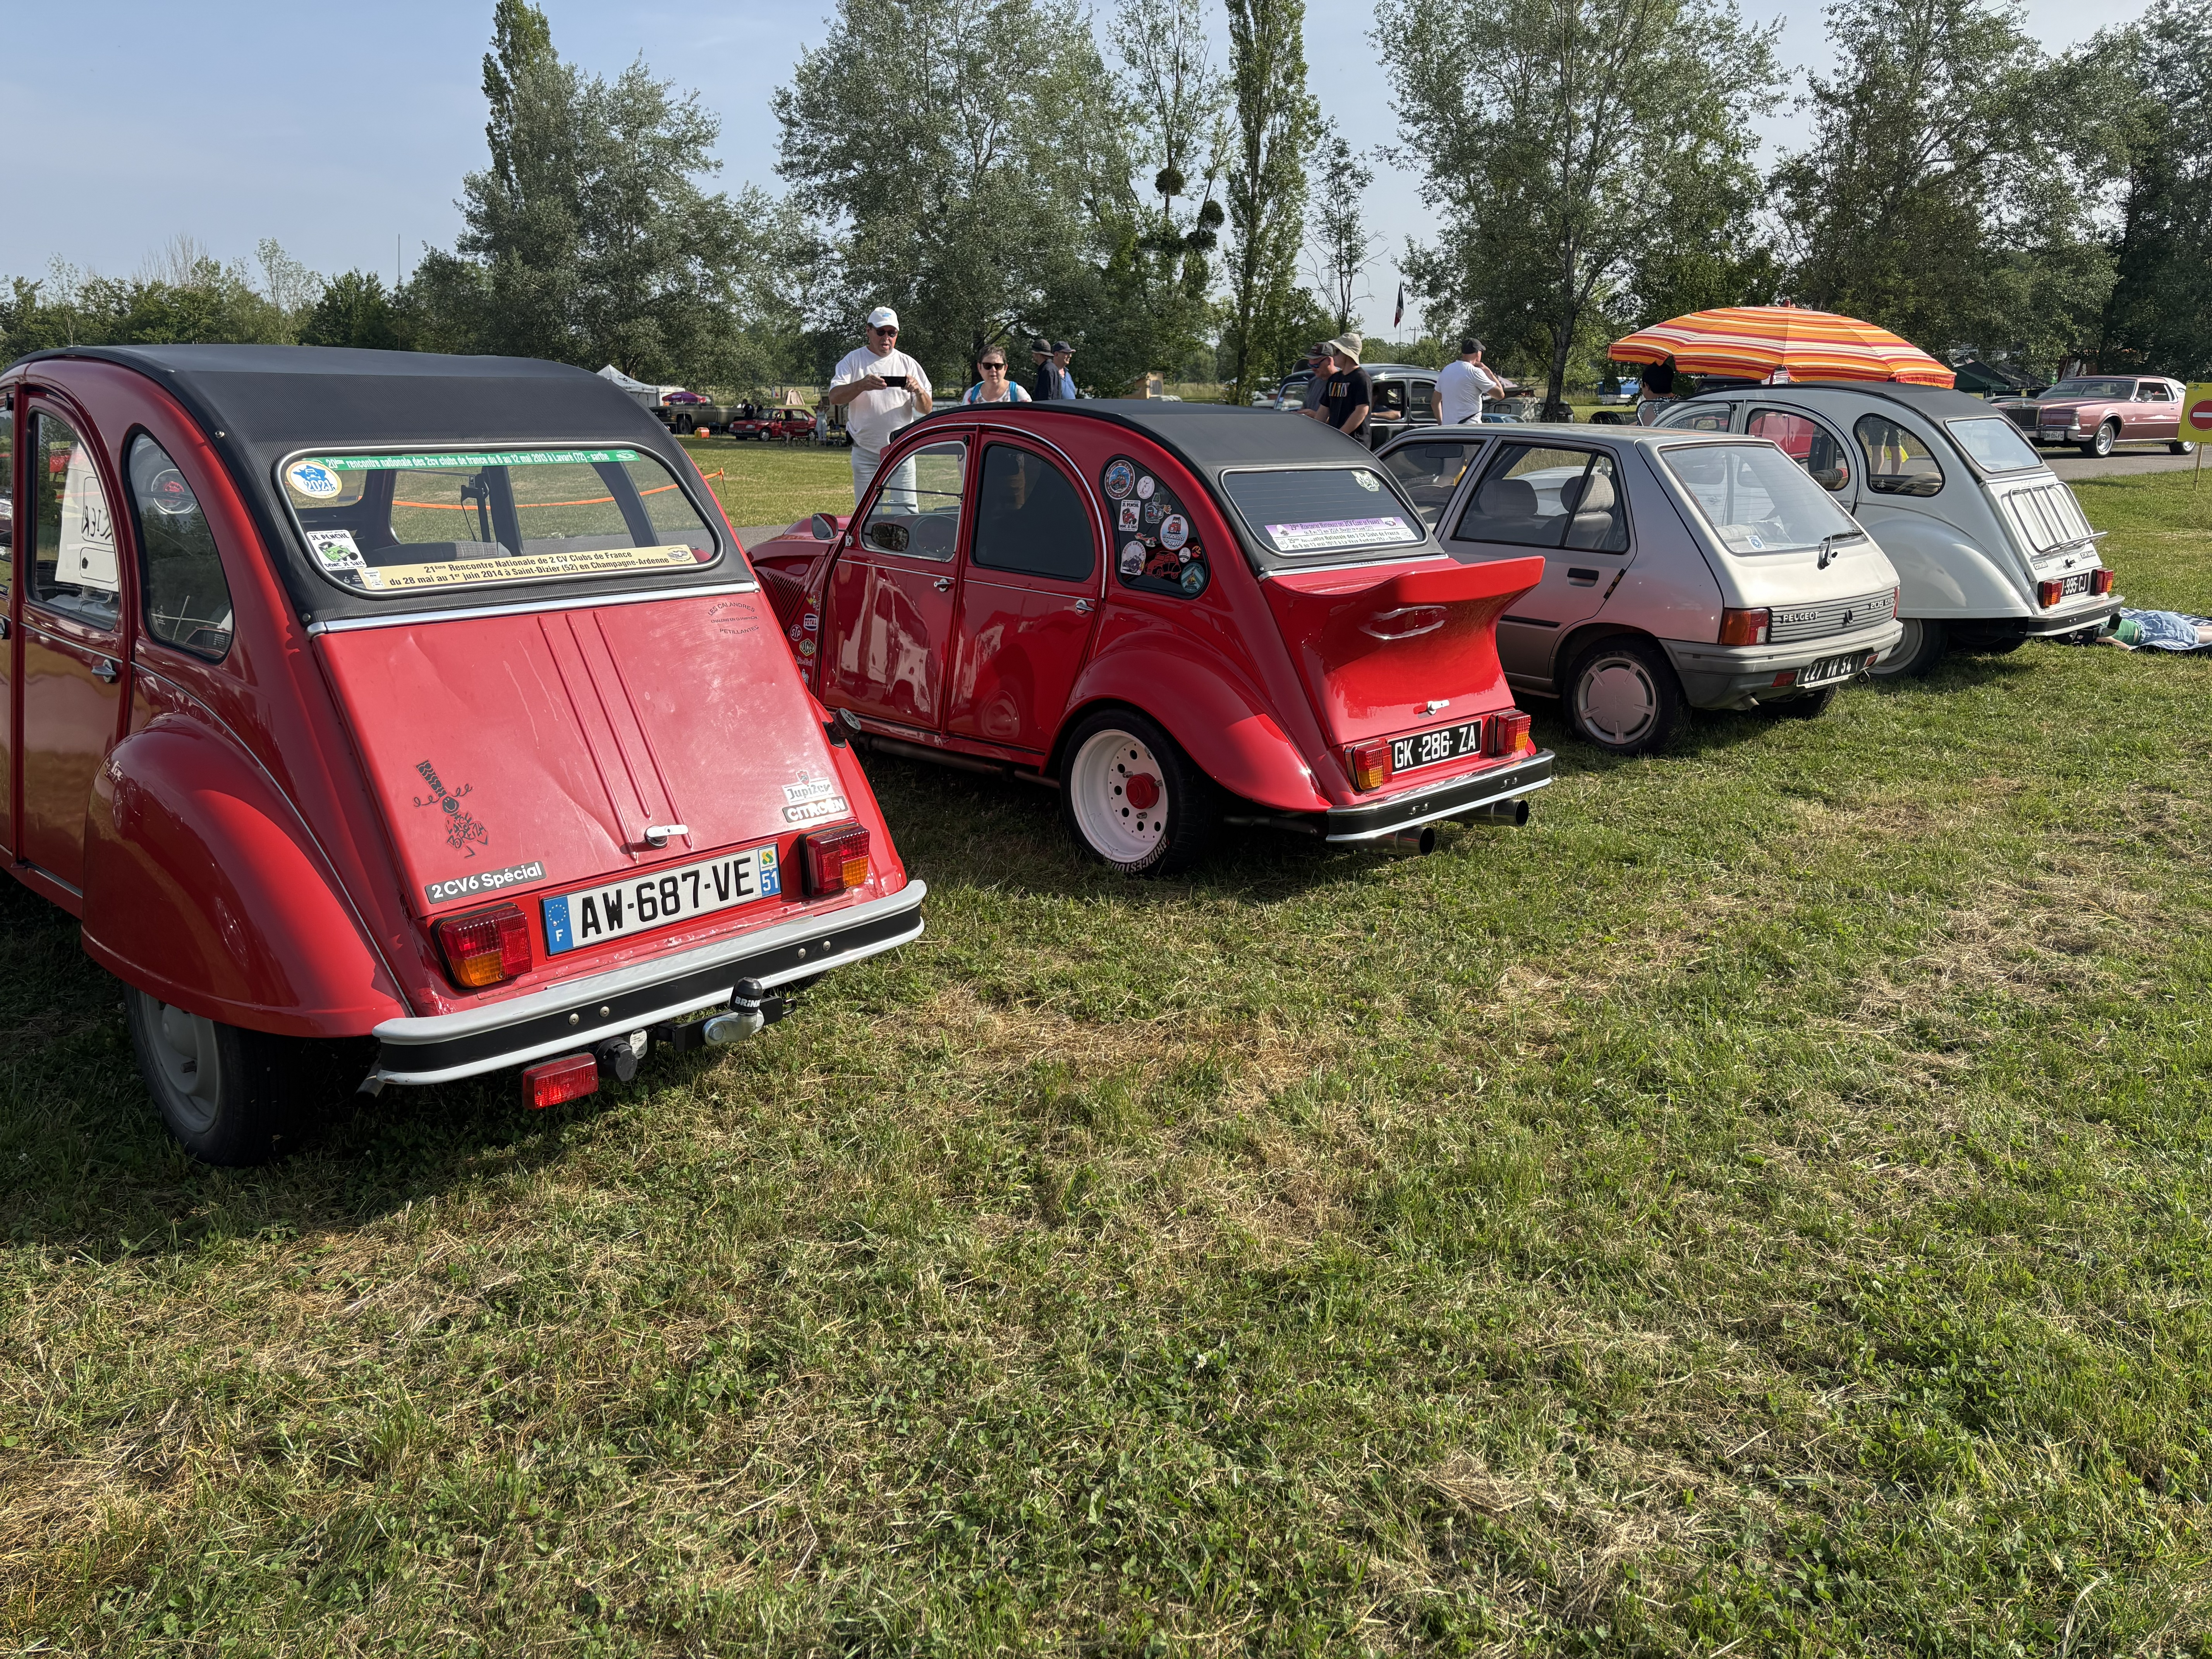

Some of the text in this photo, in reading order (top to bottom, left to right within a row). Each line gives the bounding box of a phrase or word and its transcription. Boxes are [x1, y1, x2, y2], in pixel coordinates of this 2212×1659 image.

[346, 460, 380, 469] rencontre
[380, 458, 412, 468] nationale
[412, 457, 425, 467] des
[425, 457, 439, 466] 2cv
[439, 455, 457, 466] clubs
[457, 455, 466, 465] de
[467, 455, 488, 464] france
[488, 455, 496, 464] du
[497, 454, 502, 464] 8
[512, 454, 520, 463] 12
[531, 453, 548, 463] 2013
[548, 453, 553, 462] à
[554, 452, 572, 462] Lavaré
[573, 452, 587, 463] (72)
[591, 452, 610, 461] sarthe
[304, 480, 331, 491] 2021
[390, 578, 401, 586] du
[403, 576, 416, 584] 28
[417, 574, 434, 583] mai
[449, 572, 461, 580] 1er
[462, 571, 480, 581] juin
[481, 569, 503, 578] 2014
[505, 568, 512, 576] à
[512, 565, 560, 575] Saint-Dizier
[563, 563, 578, 572] (52)
[591, 556, 669, 569] Champagne-Ardenne
[424, 565, 446, 574] 21ème
[449, 562, 494, 572] Rencontre
[495, 558, 535, 567] Nationale
[569, 553, 591, 562] Clubs
[605, 551, 632, 559] France
[2061, 575, 2087, 596] J-995-CJ
[708, 602, 755, 616] LES CALANDRES
[1870, 601, 1884, 609] 205
[1783, 611, 1819, 622] PEUGEOT
[720, 625, 759, 634] PETILLANTES
[792, 626, 801, 639] STP
[1805, 661, 1826, 682] 227
[1841, 655, 1853, 674] 54
[481, 862, 542, 888] Spécial
[762, 871, 778, 891] 51
[581, 857, 754, 939] AW-687-VE
[555, 929, 563, 942] F
